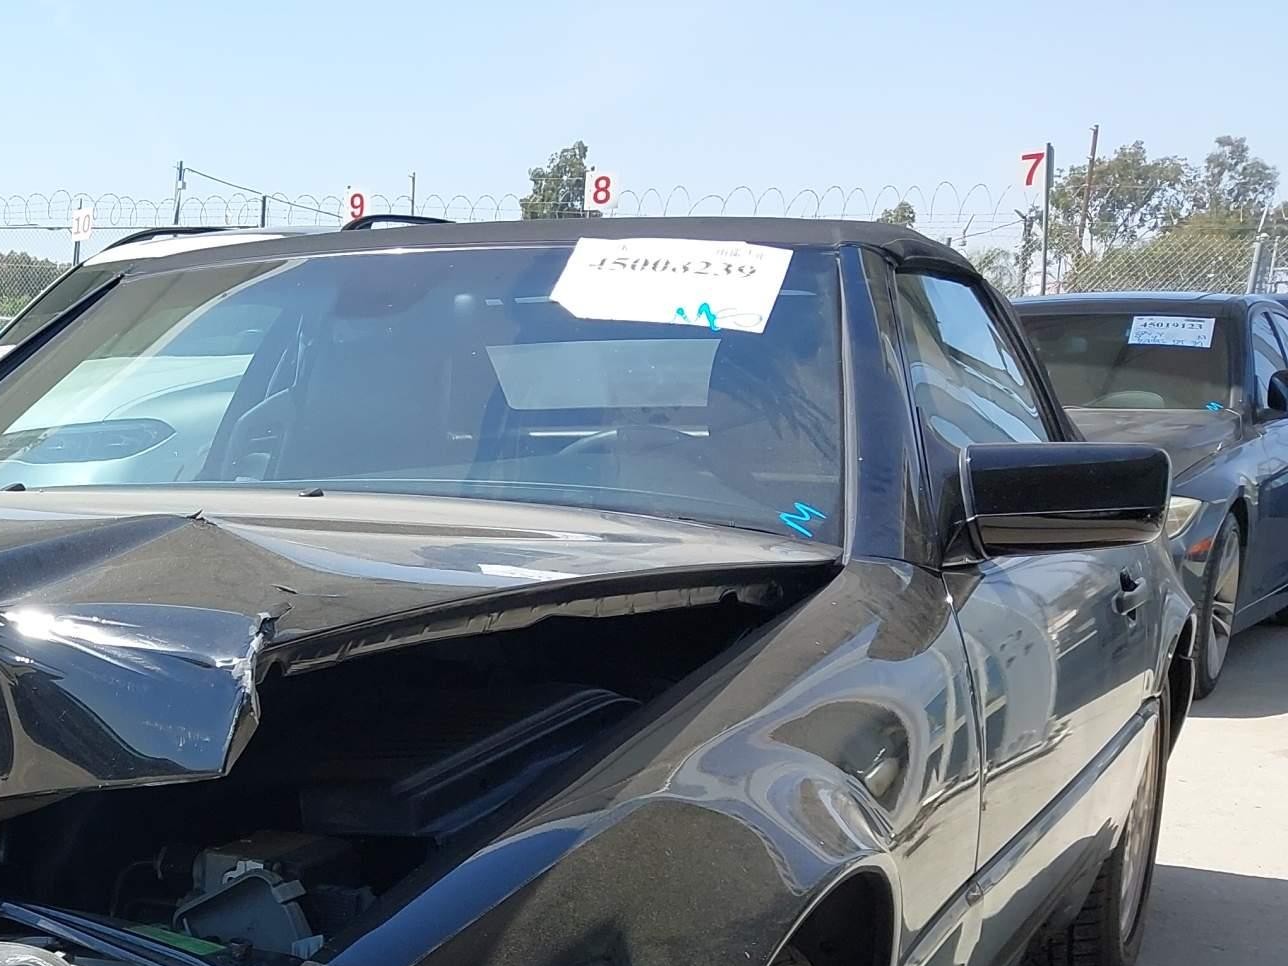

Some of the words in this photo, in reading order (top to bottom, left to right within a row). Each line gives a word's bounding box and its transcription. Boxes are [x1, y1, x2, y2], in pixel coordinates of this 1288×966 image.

[1021, 152, 1044, 186] 7
[593, 175, 612, 205] 8
[350, 192, 365, 219] 9
[73, 213, 91, 235] 10
[1140, 321, 1203, 331] 45019123
